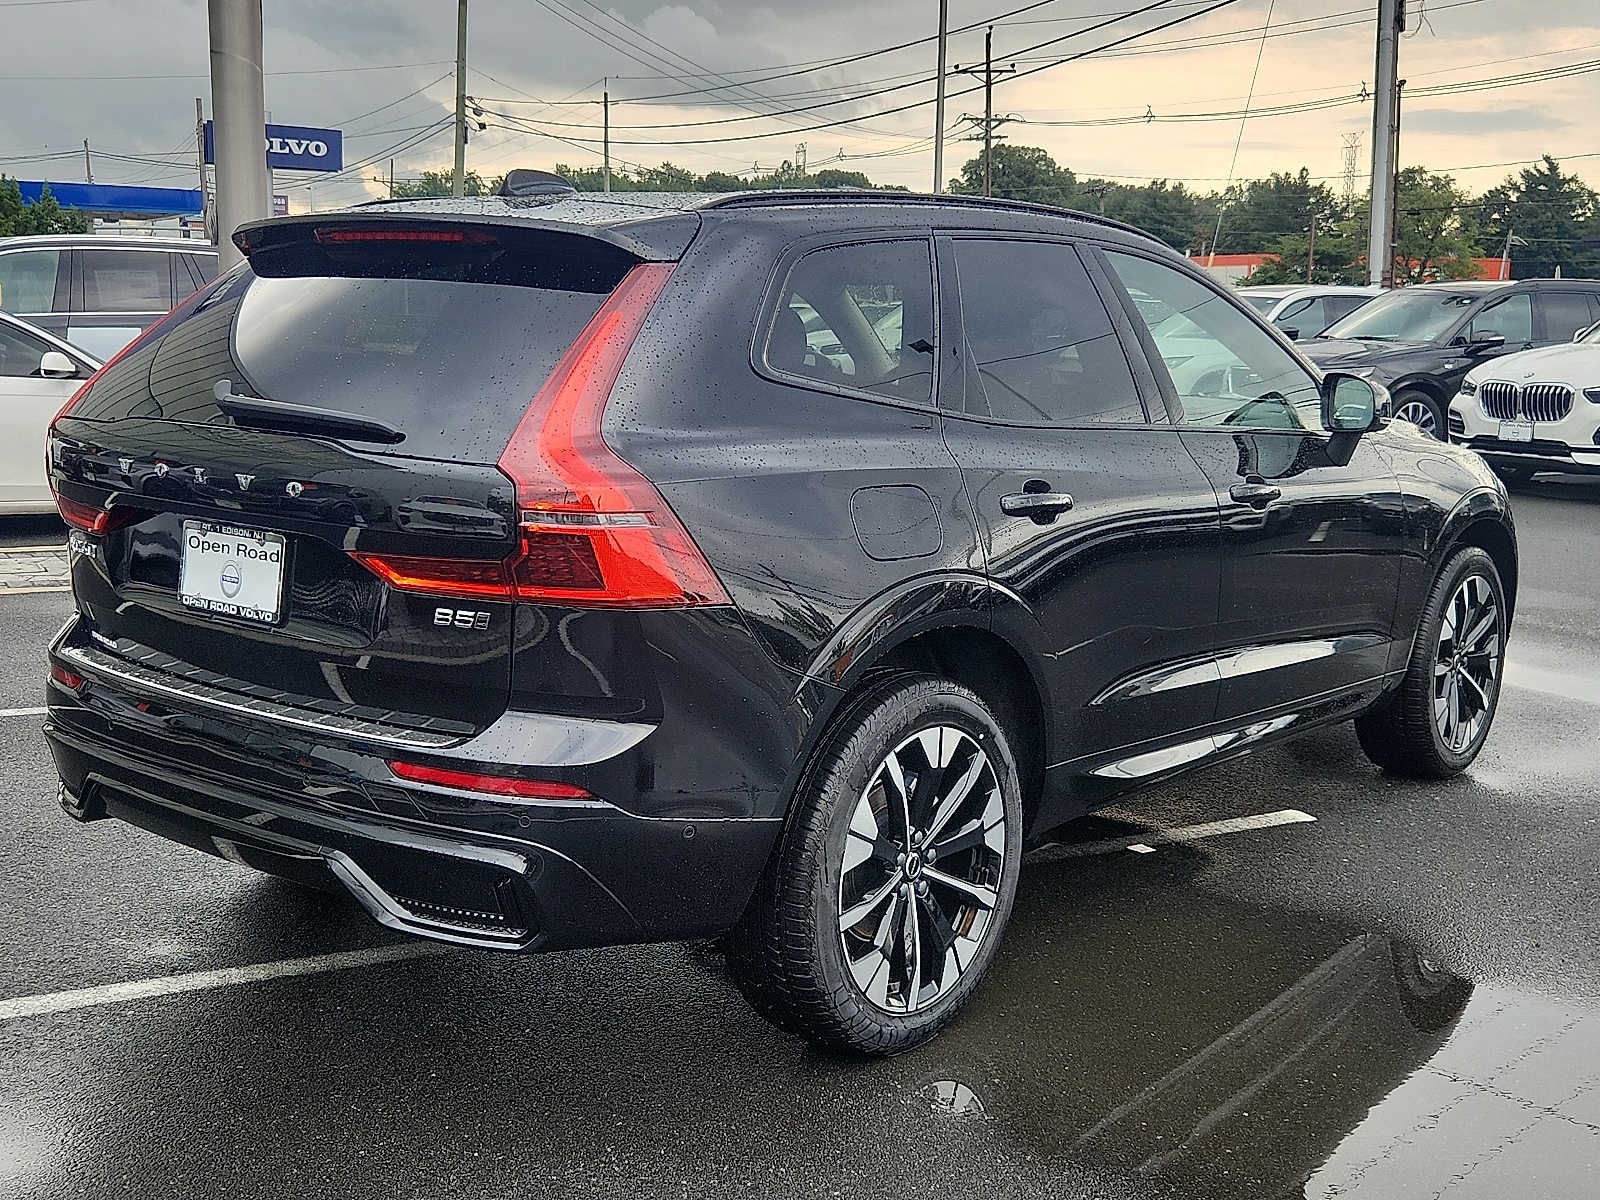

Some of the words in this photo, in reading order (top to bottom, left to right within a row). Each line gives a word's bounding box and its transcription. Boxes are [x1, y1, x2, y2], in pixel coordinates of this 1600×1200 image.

[265, 137, 328, 157] LVO
[118, 457, 303, 499] VOLVO
[189, 536, 230, 554] Open
[237, 543, 280, 563] Road
[182, 595, 208, 609] OPEN
[210, 601, 237, 614] ROAD
[239, 606, 273, 621] VOLVO
